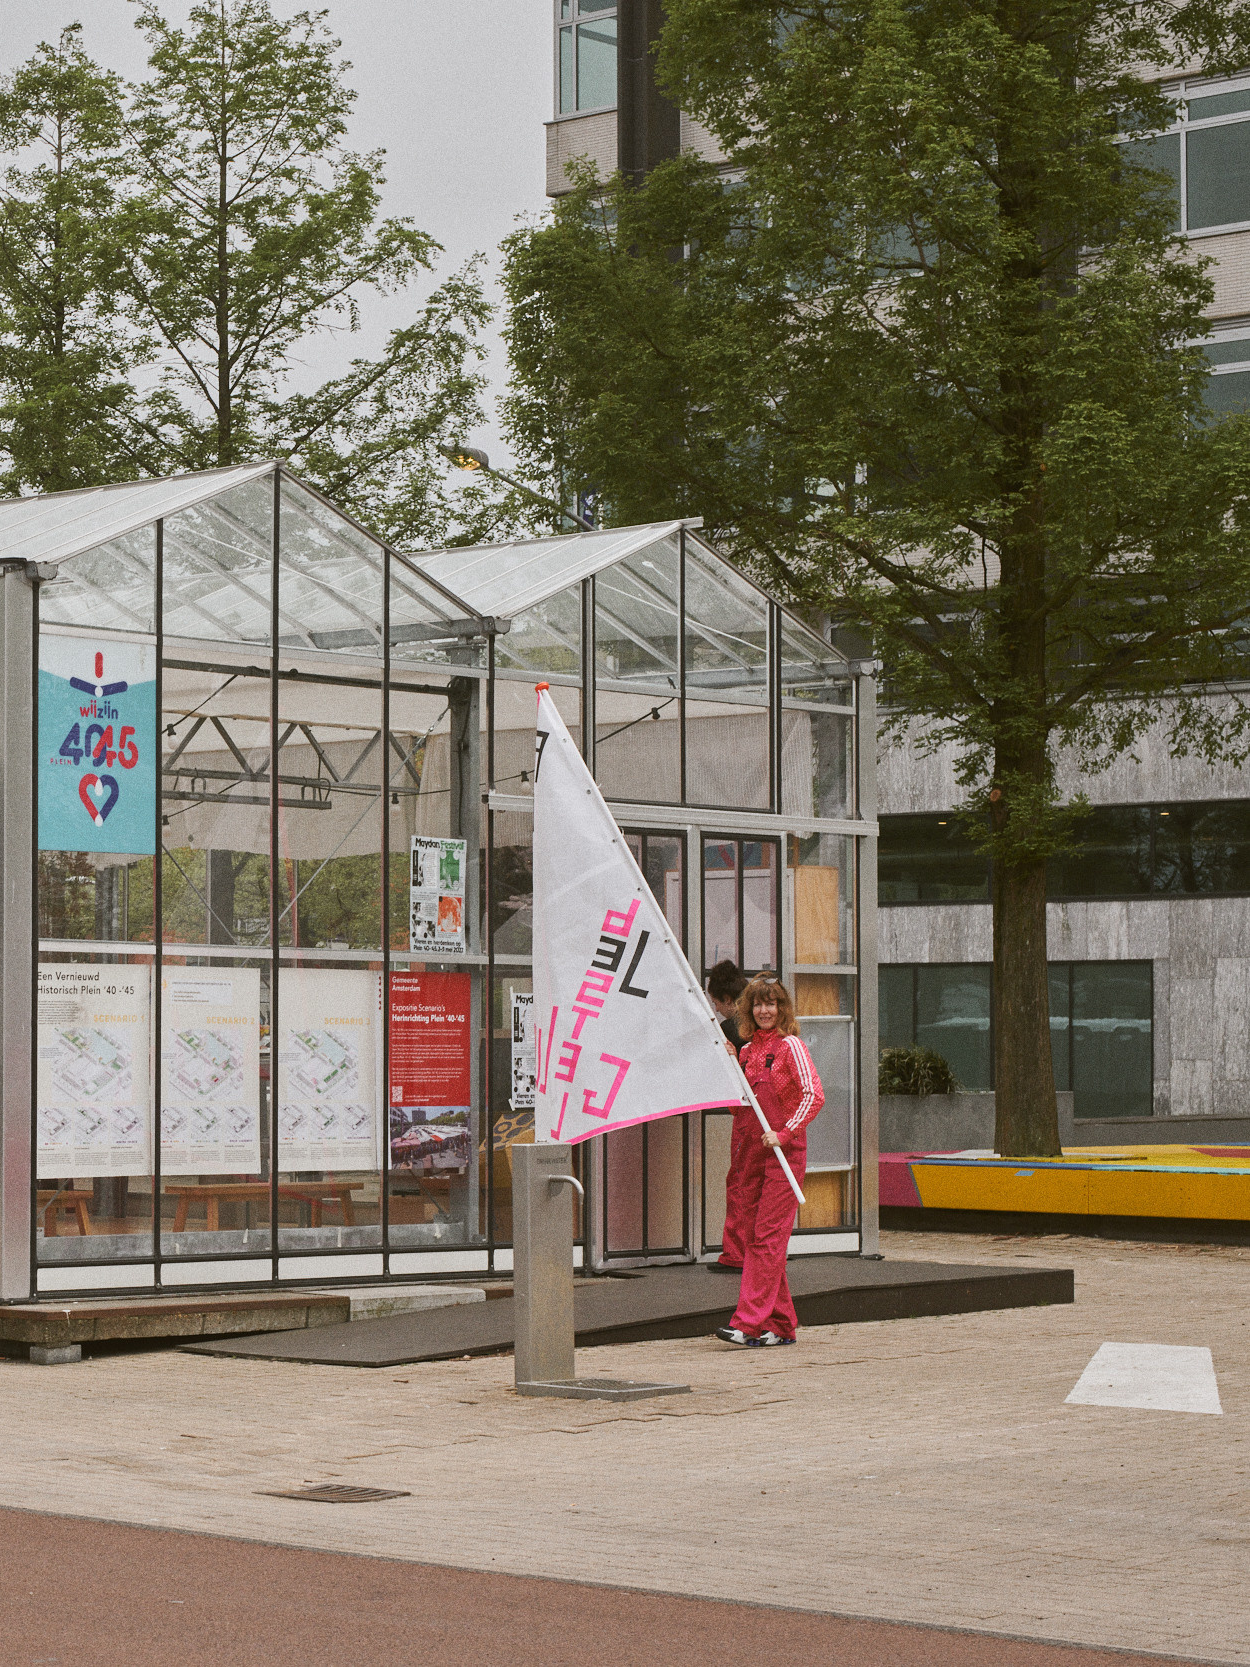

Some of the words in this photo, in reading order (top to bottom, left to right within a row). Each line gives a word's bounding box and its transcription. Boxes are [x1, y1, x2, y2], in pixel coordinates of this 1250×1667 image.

[49, 757, 73, 766] PLEIN
[415, 838, 440, 850] Maydan
[440, 840, 464, 852] Festival
[37, 971, 53, 981] Een
[55, 971, 100, 981] Vernieuwd
[392, 976, 418, 984] Gemeente
[37, 985, 78, 995] Historisch
[81, 985, 101, 995] Plein
[392, 984, 421, 992] Amsterdam
[516, 995, 534, 1006] Mayd
[392, 1004, 418, 1013] Expositie
[418, 1004, 446, 1012] Scenario's
[93, 1014, 138, 1023] SCENARIO
[206, 1016, 248, 1025] SCENARIO
[324, 1017, 364, 1025] SCENARIO
